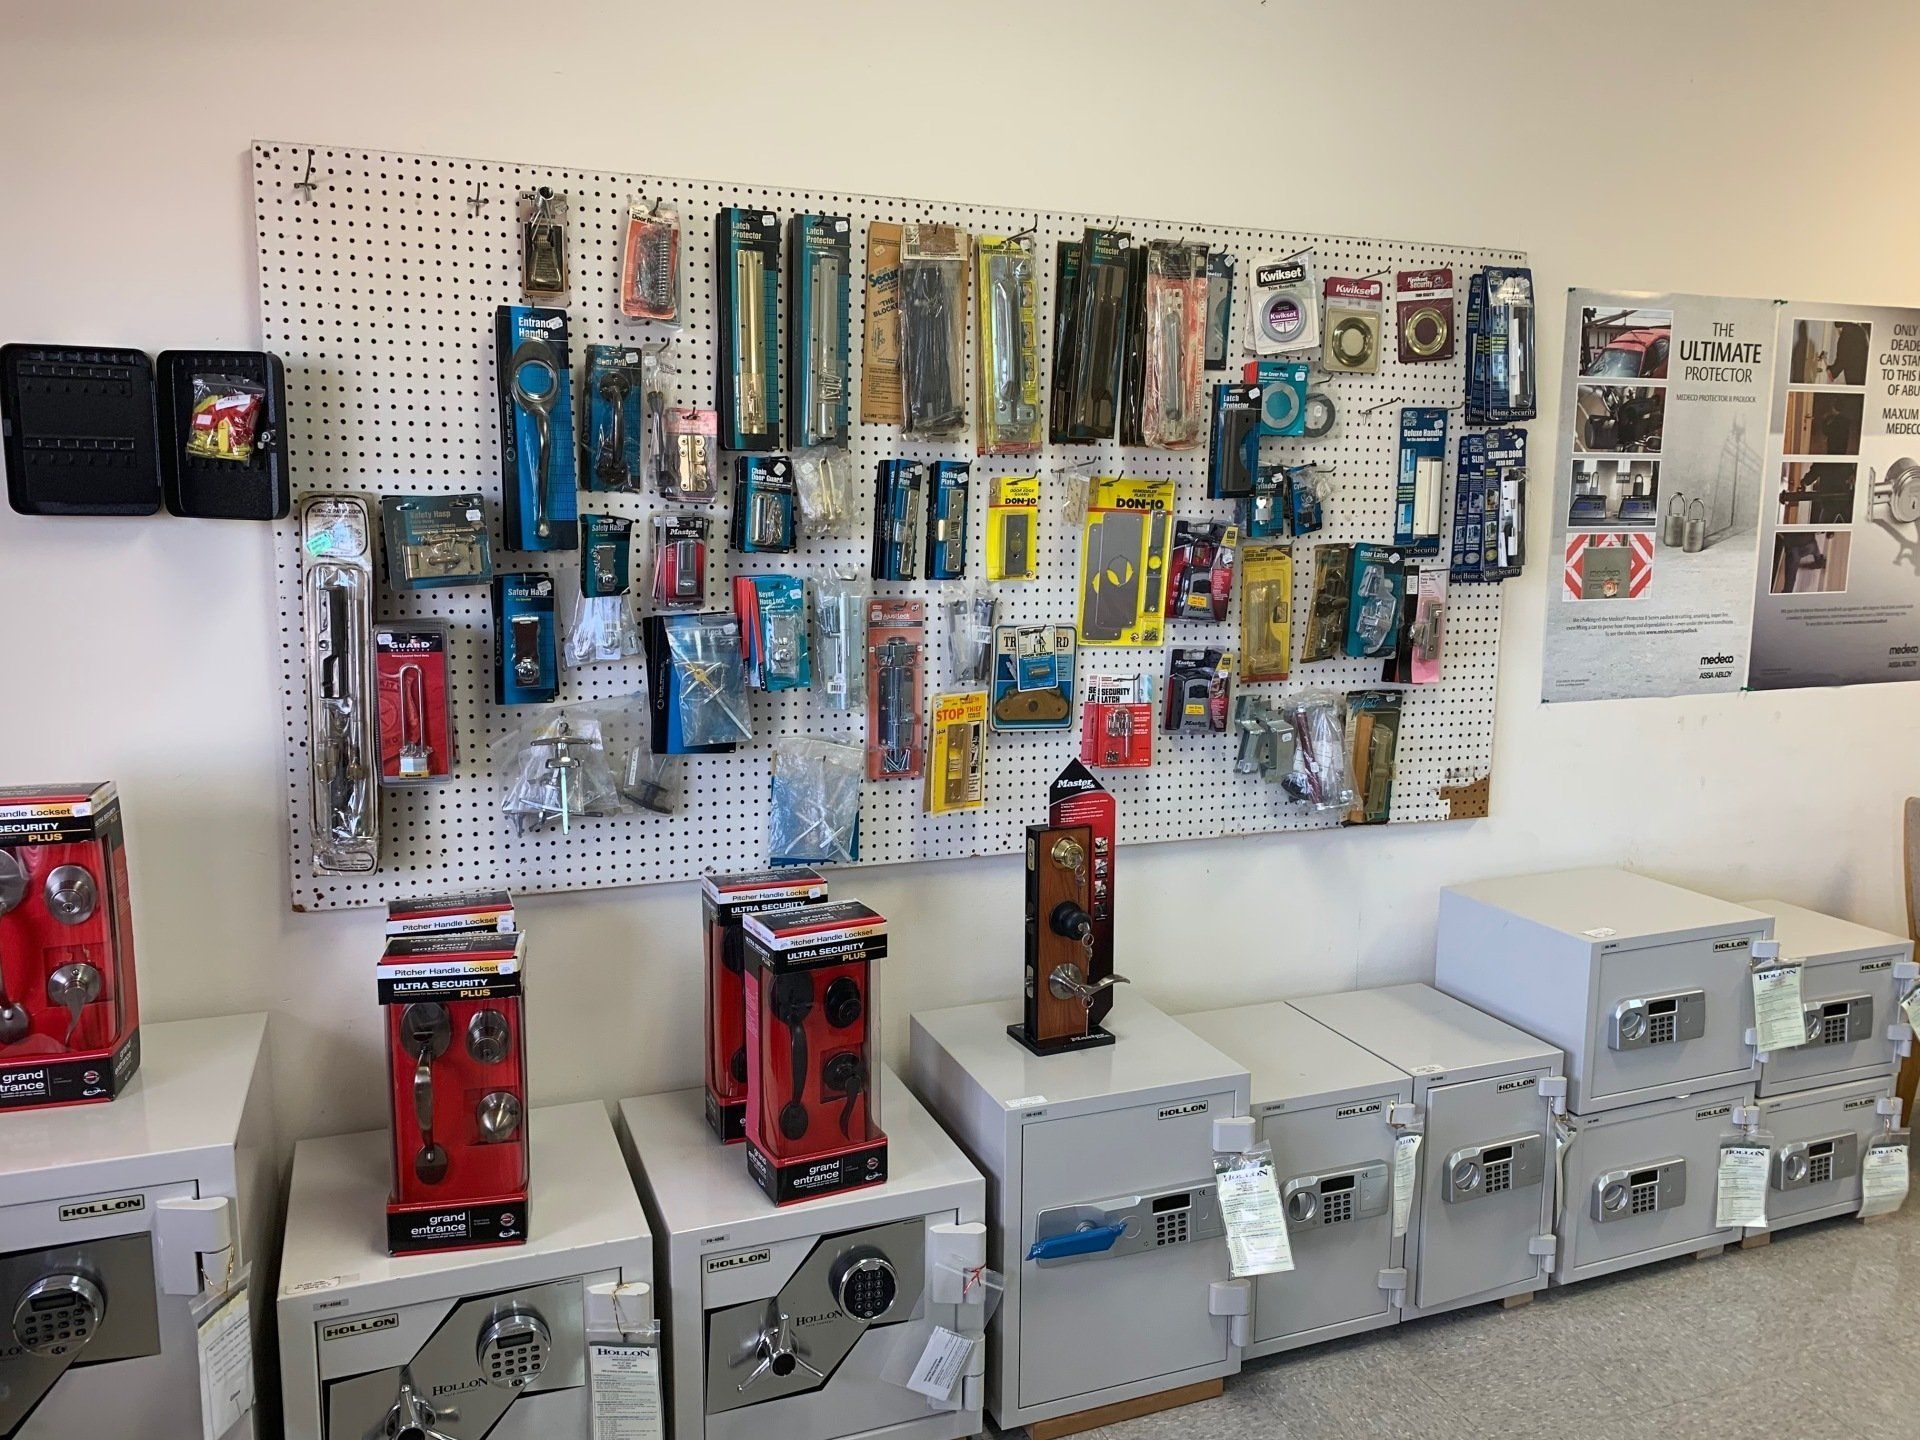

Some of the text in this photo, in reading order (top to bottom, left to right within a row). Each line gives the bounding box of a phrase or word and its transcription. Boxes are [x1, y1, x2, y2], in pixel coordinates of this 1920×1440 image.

[733, 222, 750, 230] Latch
[806, 227, 824, 236] Latch
[733, 230, 762, 240] Protector
[806, 236, 835, 245] Protector
[1094, 246, 1120, 256] Protector
[1260, 267, 1302, 283] Kwikset
[1336, 284, 1374, 295] Kwikse
[1270, 312, 1297, 320] Kwikset
[518, 316, 552, 328] Entranc
[518, 328, 550, 339] Handle
[1712, 322, 1735, 337] THE
[1894, 323, 1918, 336] ONLY
[1680, 340, 1762, 364] ULTIMATE
[1880, 354, 1900, 366] CAN
[1685, 366, 1752, 382] PROTECTOR
[1881, 369, 1917, 381] TO THIS
[1887, 384, 1920, 396] OF ABU
[1223, 394, 1240, 402] Latch
[1699, 394, 1729, 402] PROTECTOR
[1492, 408, 1536, 418] Home Security
[1882, 408, 1919, 420] MAXUM
[1403, 429, 1443, 437] Deluxe Handle
[1488, 450, 1522, 459] SLIDING DOOR
[752, 467, 767, 475] Chain
[765, 475, 783, 483] Guard
[1116, 498, 1164, 510] DON-JO
[411, 510, 451, 521] Safety Hasp
[592, 523, 625, 532] Safety Hasp
[670, 528, 697, 536] Master
[508, 587, 548, 596] Safety Hasp
[1889, 643, 1919, 655] medeco
[1700, 652, 1734, 665] medeco
[1699, 670, 1733, 680] ASSA ABLOY
[1101, 688, 1130, 696] SECURITY
[1101, 695, 1120, 703] LATCH
[936, 708, 965, 721] STOP
[967, 705, 982, 713] THIEF
[1057, 779, 1092, 788] Master
[0, 808, 71, 818] andle Lockset
[0, 822, 59, 833] SECURITY
[28, 834, 63, 842] PLUS
[732, 893, 758, 901] Pitcher
[785, 889, 809, 897] Locks
[731, 901, 806, 914] ULTRA SECURITY
[402, 917, 498, 932] Pitcher Handle Lockset
[816, 934, 843, 944] Handle
[844, 929, 873, 940] Lockset
[1715, 940, 1748, 950] HOLLON
[787, 943, 865, 960] ULTRA SECURITY
[842, 951, 867, 962] PLUS
[394, 965, 498, 976] Pitcher Handle Lockset
[1861, 961, 1892, 971] HOLLON
[393, 979, 488, 991] ULTRA SECURITY
[460, 988, 491, 998] PLUS
[2, 1070, 44, 1083] grand
[0, 1081, 44, 1093] trance
[1498, 1078, 1535, 1091] HOLLON
[1845, 1099, 1875, 1109] HOLLON
[1159, 1103, 1207, 1117] HOLLON
[1338, 1104, 1380, 1117] HOLLON
[1697, 1107, 1730, 1118] HOLLON
[809, 1160, 840, 1176] grand
[793, 1170, 839, 1186] entrance
[62, 1198, 142, 1218] HOLLON
[429, 1212, 466, 1225] grand
[411, 1222, 466, 1235] entrance
[709, 1252, 768, 1270] HOLLON
[796, 1310, 843, 1327] HOLLON
[327, 1317, 395, 1337] HOLLON
[597, 1348, 650, 1357] HOLLON
[432, 1377, 487, 1397] HOLLON
